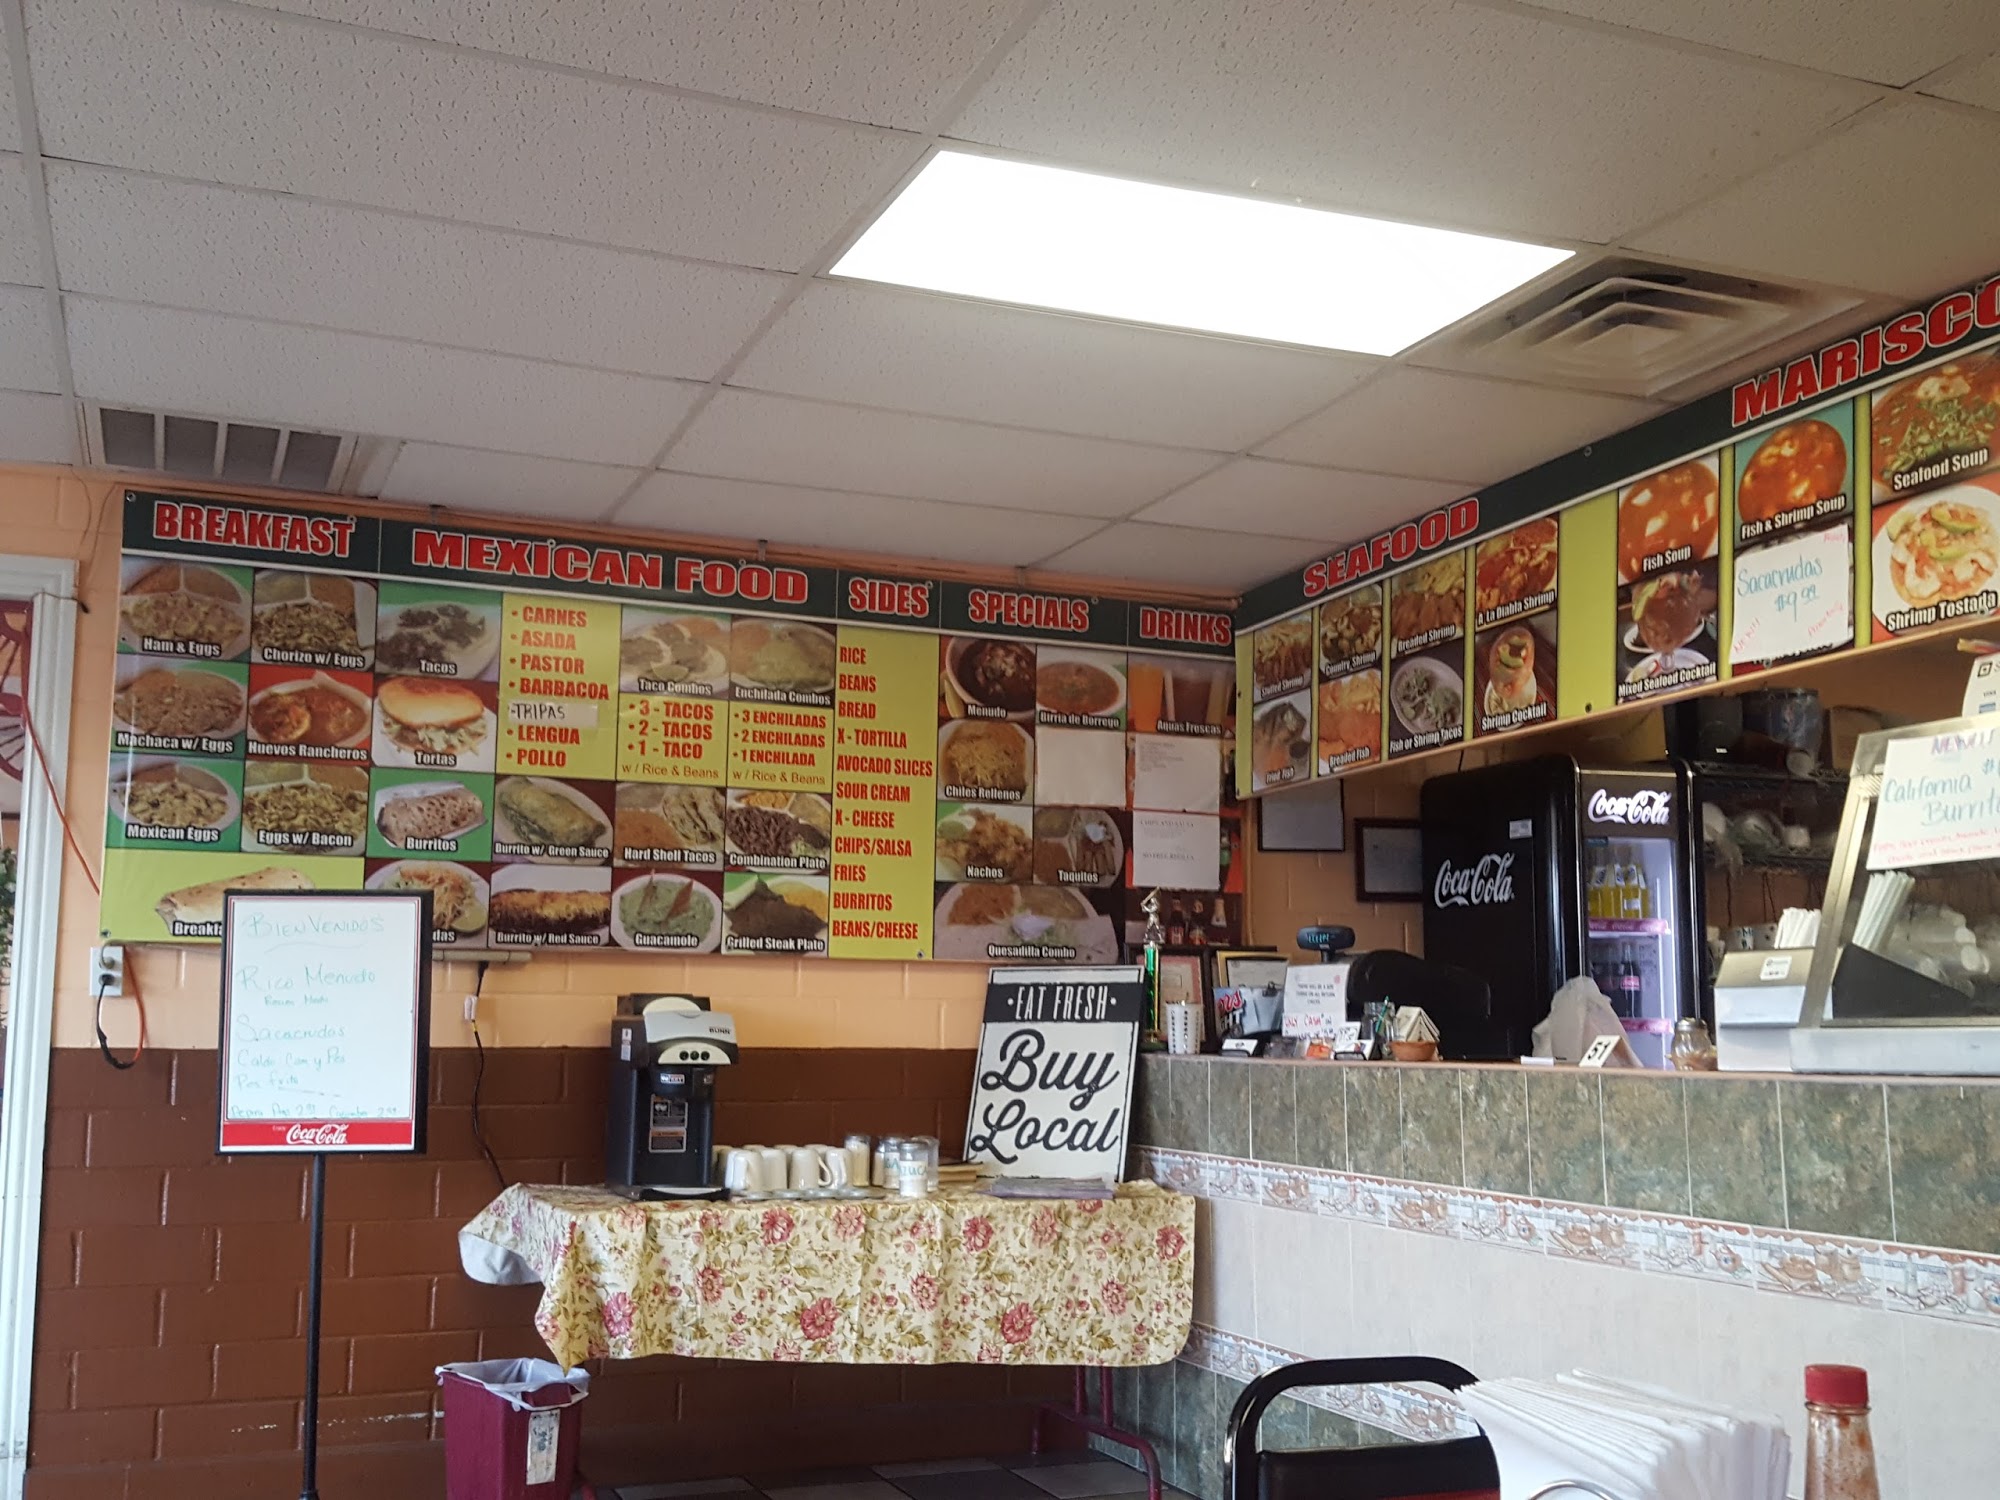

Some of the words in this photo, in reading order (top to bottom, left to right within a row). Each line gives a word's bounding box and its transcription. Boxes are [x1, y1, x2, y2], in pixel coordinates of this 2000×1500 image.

[1893, 461, 1948, 490] Seafood
[1951, 447, 1988, 472] Soup
[1742, 522, 1763, 539] Fish
[1765, 519, 1773, 530] &
[1775, 507, 1814, 528] Shrimp
[1816, 496, 1845, 513] Soup
[153, 501, 354, 557] BREAKFAST
[1303, 498, 1479, 598] SEAFOOD
[412, 528, 662, 590] MEXICAN
[675, 557, 808, 603] FOOD
[1643, 555, 1663, 572] Fish
[1665, 546, 1691, 564] Soup
[849, 577, 929, 617] SIDES
[522, 606, 587, 628] CARNES
[969, 588, 1089, 632] SPECIALS
[1478, 614, 1483, 624] A
[1486, 611, 1494, 622] La
[1497, 603, 1522, 619] Diabla
[1524, 591, 1554, 609] Shrimp
[1886, 603, 1936, 632] Shrimp
[1939, 591, 1997, 619] Tostada
[1140, 606, 1231, 646] DRINKS
[143, 637, 174, 653] Ham
[176, 642, 186, 654] &
[188, 641, 221, 658] Eggs
[521, 630, 576, 650] ASADA
[1398, 634, 1427, 651] Breaded
[1429, 625, 1455, 640] Shrimp
[263, 647, 312, 664] Chorizo
[314, 651, 332, 664] w/
[334, 654, 363, 668] Eggs
[521, 653, 584, 674] PASTOR
[839, 646, 866, 665] RICE
[1352, 652, 1376, 666] Shrimp
[420, 660, 456, 675] Tacos
[520, 678, 609, 700] BARBACOA
[639, 679, 666, 693] Taco
[667, 681, 712, 695] Combos
[839, 674, 876, 693] BEANS
[1619, 679, 1643, 697] Mixed
[1644, 670, 1678, 689] Seafood
[1679, 663, 1716, 682] Cocktail
[736, 687, 786, 702] Enchilada
[789, 691, 831, 706] Combos
[639, 700, 650, 716] 3
[663, 701, 713, 721] TACOS
[742, 711, 750, 723] 3
[753, 711, 826, 729] ENCHILADAS
[838, 701, 876, 719] BREAD
[968, 706, 1006, 718] Menudo
[1069, 715, 1080, 725] de
[1482, 714, 1511, 730] Shrimp
[1512, 703, 1546, 722] Cocktail
[518, 725, 580, 745] LENGUA
[639, 720, 649, 736] 2
[662, 722, 712, 740] TACOS
[742, 730, 749, 743] 2
[752, 731, 825, 748] ENCHILADAS
[838, 728, 845, 744] X
[854, 729, 907, 749] TORTILLA
[1390, 740, 1403, 753] Fish
[1405, 739, 1411, 749] or
[1414, 730, 1440, 747] Shrimp
[1440, 726, 1462, 742] Tacos
[117, 732, 179, 749] Machaca
[181, 738, 198, 751] w/
[200, 738, 233, 754] Eggs
[248, 741, 296, 758] Huevos
[299, 743, 367, 761] Rancheros
[639, 740, 646, 755] 1
[662, 742, 703, 759] TACO
[416, 753, 456, 766] Tortas
[517, 748, 567, 768] POLLO
[742, 750, 747, 763] 1
[750, 750, 815, 766] ENCHILADA
[837, 755, 891, 774] AVOCADO
[894, 759, 933, 777] SLICES
[642, 763, 667, 776] Rice
[672, 765, 680, 777] &
[684, 766, 719, 779] Beans
[752, 770, 776, 782] Rice
[779, 772, 788, 783] &
[791, 773, 825, 785] Beans
[836, 782, 868, 800] SOUR
[871, 784, 910, 802] CREAM
[945, 786, 976, 798] Chiles
[979, 787, 1020, 800] Rellenos
[1884, 774, 1972, 802] California
[1588, 788, 1672, 825] Coca-Cola
[835, 809, 843, 826] X
[853, 810, 894, 828] CHEESE
[127, 824, 184, 840] Mexican
[186, 827, 219, 842] Eggs
[258, 830, 290, 845] Eggs
[292, 830, 308, 844] w/
[311, 833, 352, 847] Bacon
[406, 838, 457, 851] Burritos
[495, 843, 530, 855] Burrito
[531, 844, 546, 856] w/
[548, 845, 578, 858] Green
[579, 847, 609, 860] Sauce
[835, 837, 912, 857] CHIPS/SALSA
[624, 848, 650, 861] Hard
[652, 849, 681, 861] Shell
[684, 850, 715, 863] Tacos
[730, 854, 797, 867] Combination
[799, 855, 826, 869] Plate
[834, 864, 866, 882] FRIES
[967, 866, 1003, 878] Nachos
[1058, 870, 1098, 882] Taquitos
[1434, 852, 1514, 909] Coca-Cola
[833, 892, 892, 912] BURRITOS
[496, 931, 530, 943] Burrito
[548, 934, 567, 945] Red
[568, 934, 598, 945] Sauce
[635, 933, 699, 947] Guacamole
[833, 920, 918, 940] BEANS/CHEESE
[727, 936, 763, 949] Grilled
[765, 938, 795, 950] Steak
[797, 939, 824, 951] Plate
[988, 945, 1040, 957] Quesadilla
[1042, 947, 1076, 958] Combo
[1015, 986, 1046, 1020] EAT
[1053, 985, 1108, 1020] FRESH
[981, 1029, 1120, 1111] Buy
[286, 1124, 349, 1145] Coca-Cola
[970, 1099, 1120, 1164] Local
